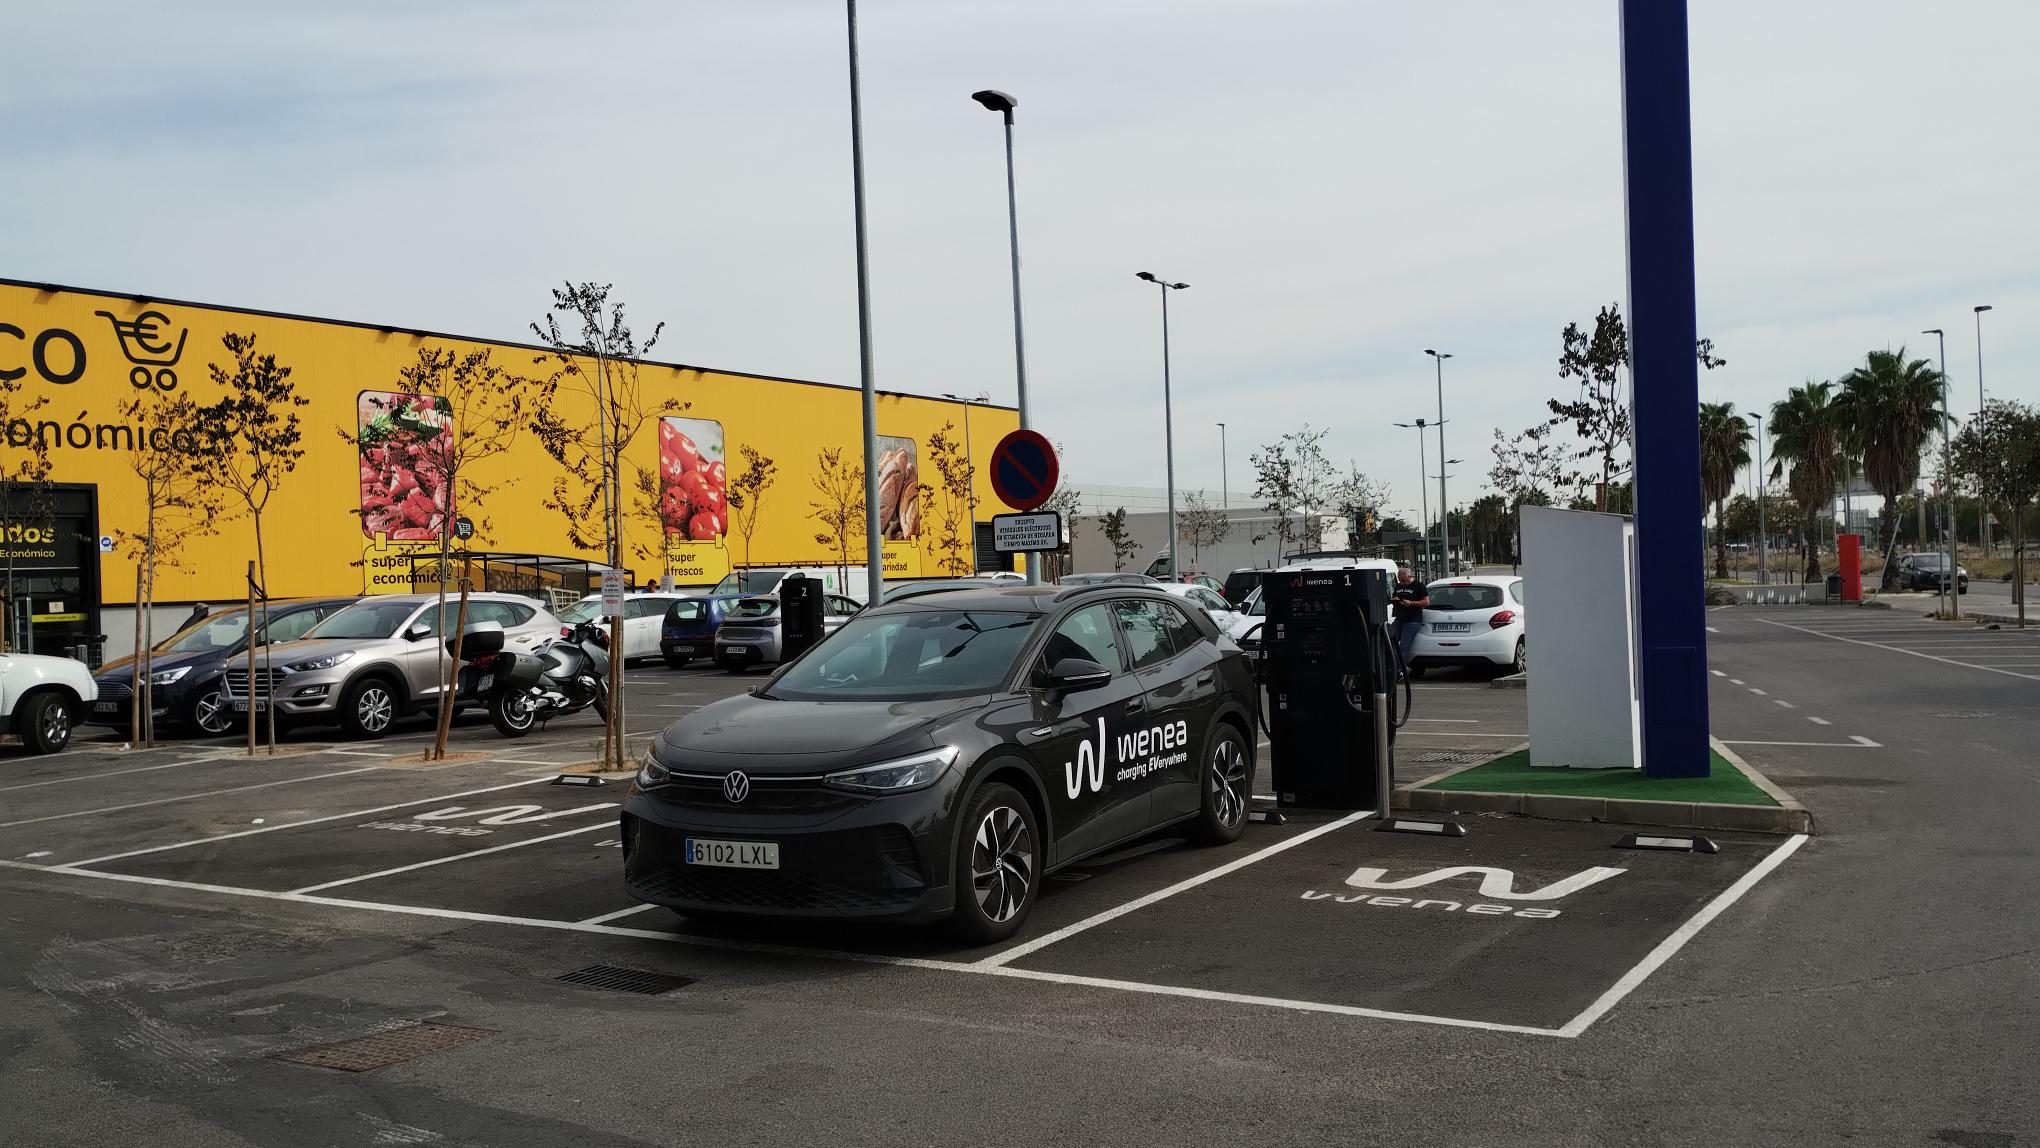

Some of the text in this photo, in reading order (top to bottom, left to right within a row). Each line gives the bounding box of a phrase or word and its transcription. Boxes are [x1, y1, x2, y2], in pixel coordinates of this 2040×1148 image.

[669, 554, 696, 564] super
[881, 551, 897, 560] uper
[372, 558, 410, 570] super
[882, 562, 908, 571] ariedad
[671, 567, 704, 576] frescos
[1343, 574, 1352, 586] 1
[801, 587, 808, 597] 2
[1117, 720, 1187, 763] wenea
[1117, 763, 1147, 781] charging
[695, 843, 773, 865] 6102 LXL
[1300, 890, 1562, 919] wenea
